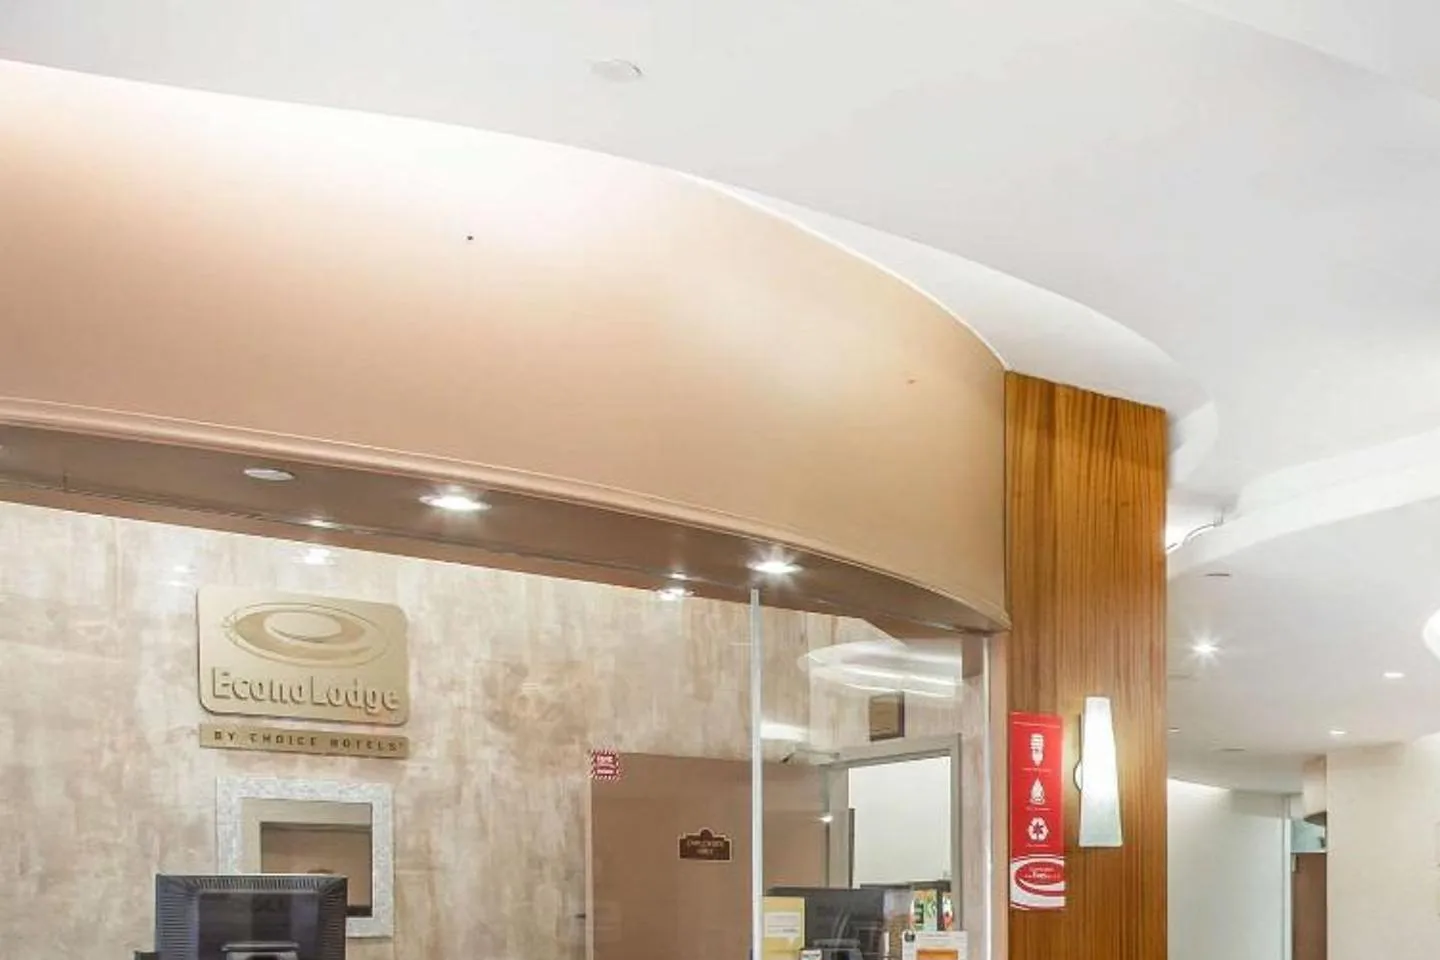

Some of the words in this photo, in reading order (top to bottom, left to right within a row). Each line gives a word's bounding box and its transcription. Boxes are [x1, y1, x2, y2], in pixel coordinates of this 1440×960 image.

[213, 730, 236, 742] BY
[250, 733, 319, 747] CHOICE
[329, 738, 399, 752] HOTELS
